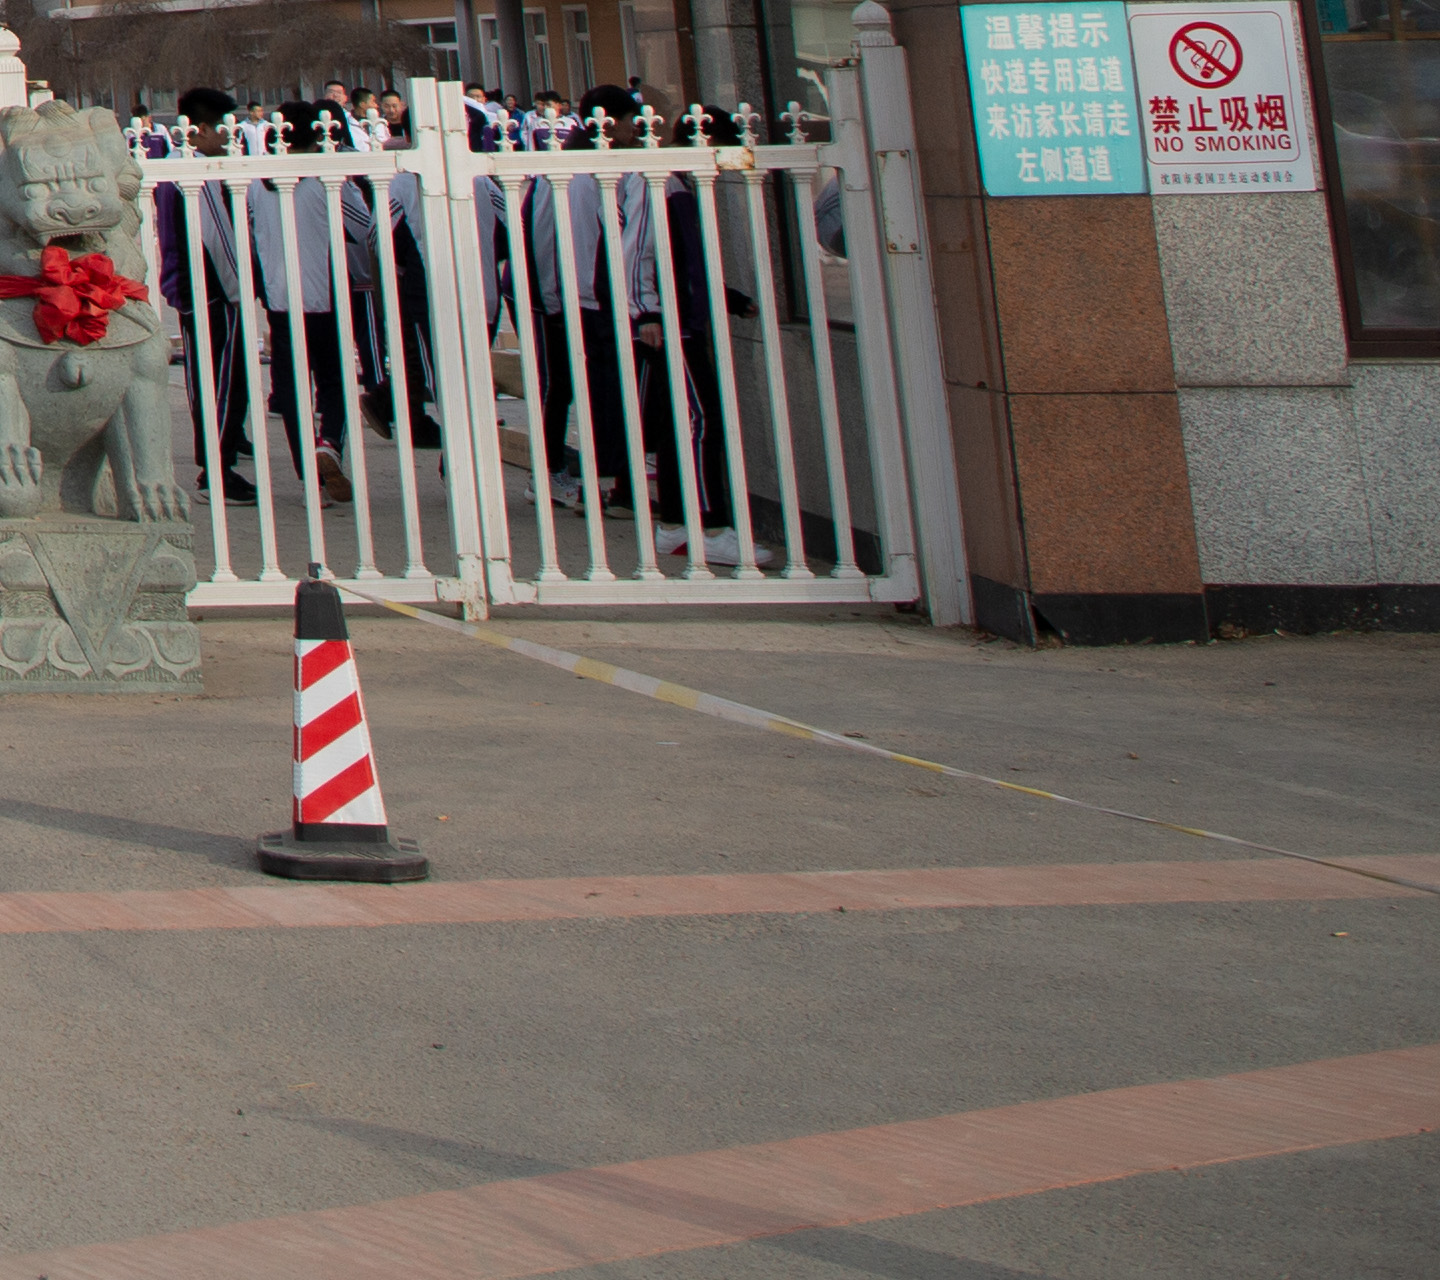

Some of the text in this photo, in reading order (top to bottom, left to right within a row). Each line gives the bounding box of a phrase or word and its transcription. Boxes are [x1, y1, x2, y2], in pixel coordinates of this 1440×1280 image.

[985, 12, 1109, 51] 温馨提示
[980, 56, 1126, 95] 快递专用通道
[986, 100, 1130, 139] 来访家长请走
[1149, 93, 1289, 134] 禁止吸烟
[1154, 134, 1292, 153] NO SMOKING
[1016, 145, 1114, 183] 左侧通道
